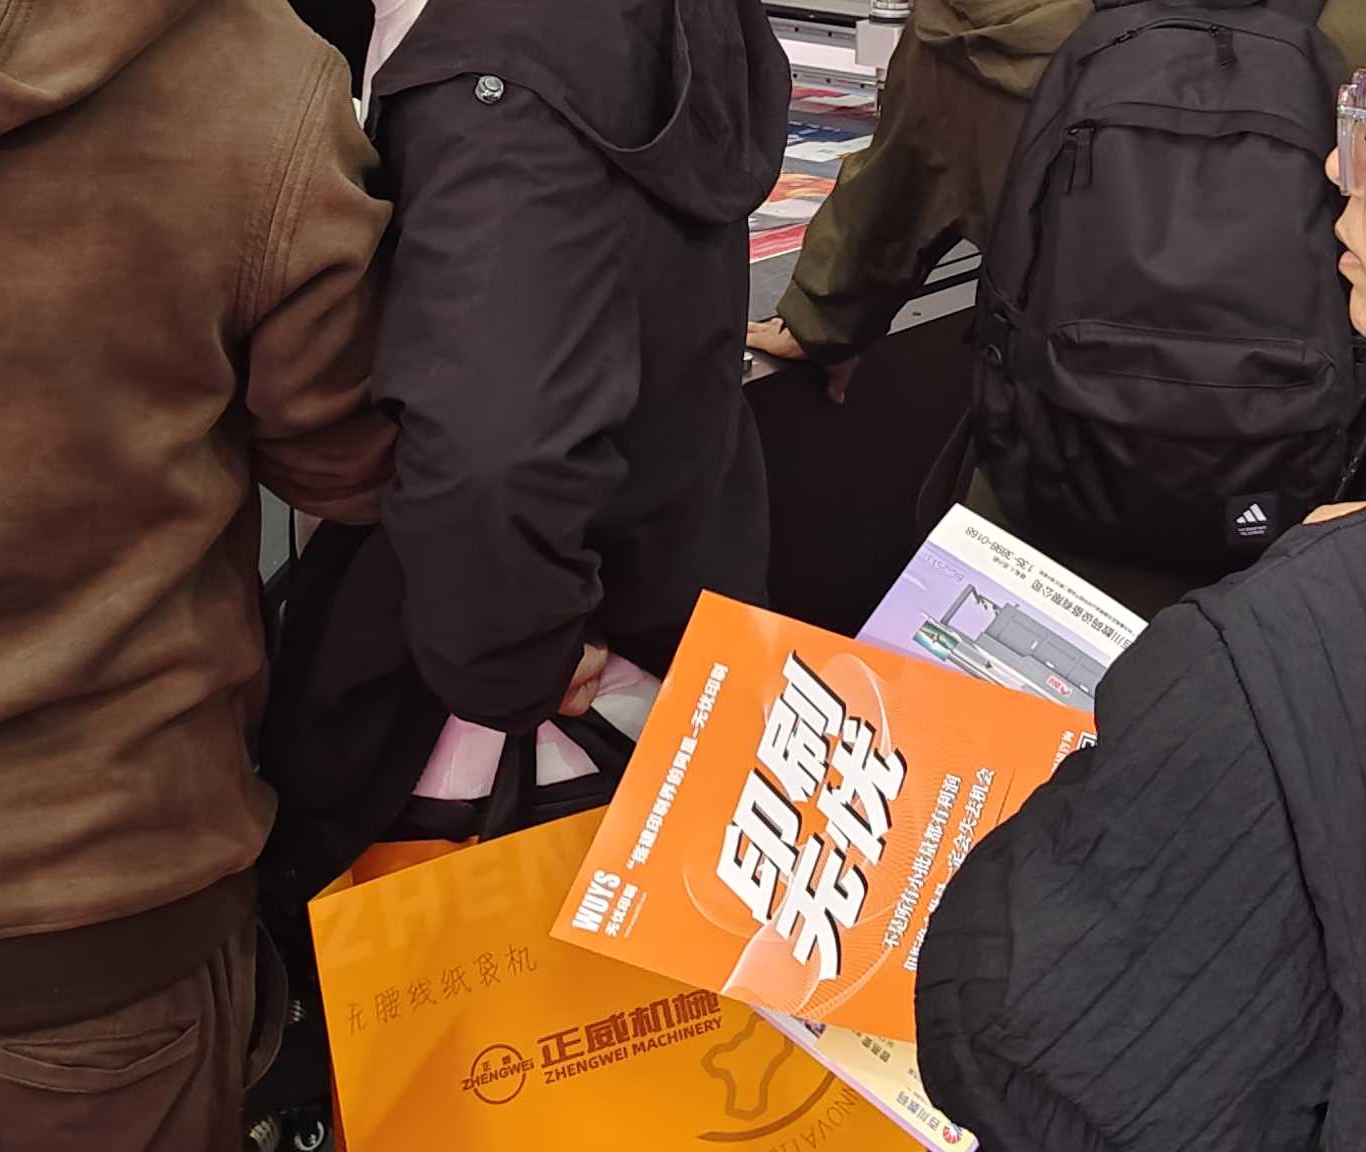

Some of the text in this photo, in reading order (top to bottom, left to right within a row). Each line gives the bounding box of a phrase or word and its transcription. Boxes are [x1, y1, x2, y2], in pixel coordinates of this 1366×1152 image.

[716, 650, 846, 925] 印刷
[774, 716, 907, 980] 无忧
[572, 869, 621, 933] WUYS
[605, 883, 638, 937] 无忧印刷
[537, 988, 721, 1068] 正威机械
[543, 1016, 723, 1085] ZHENGWEI MACHINERY
